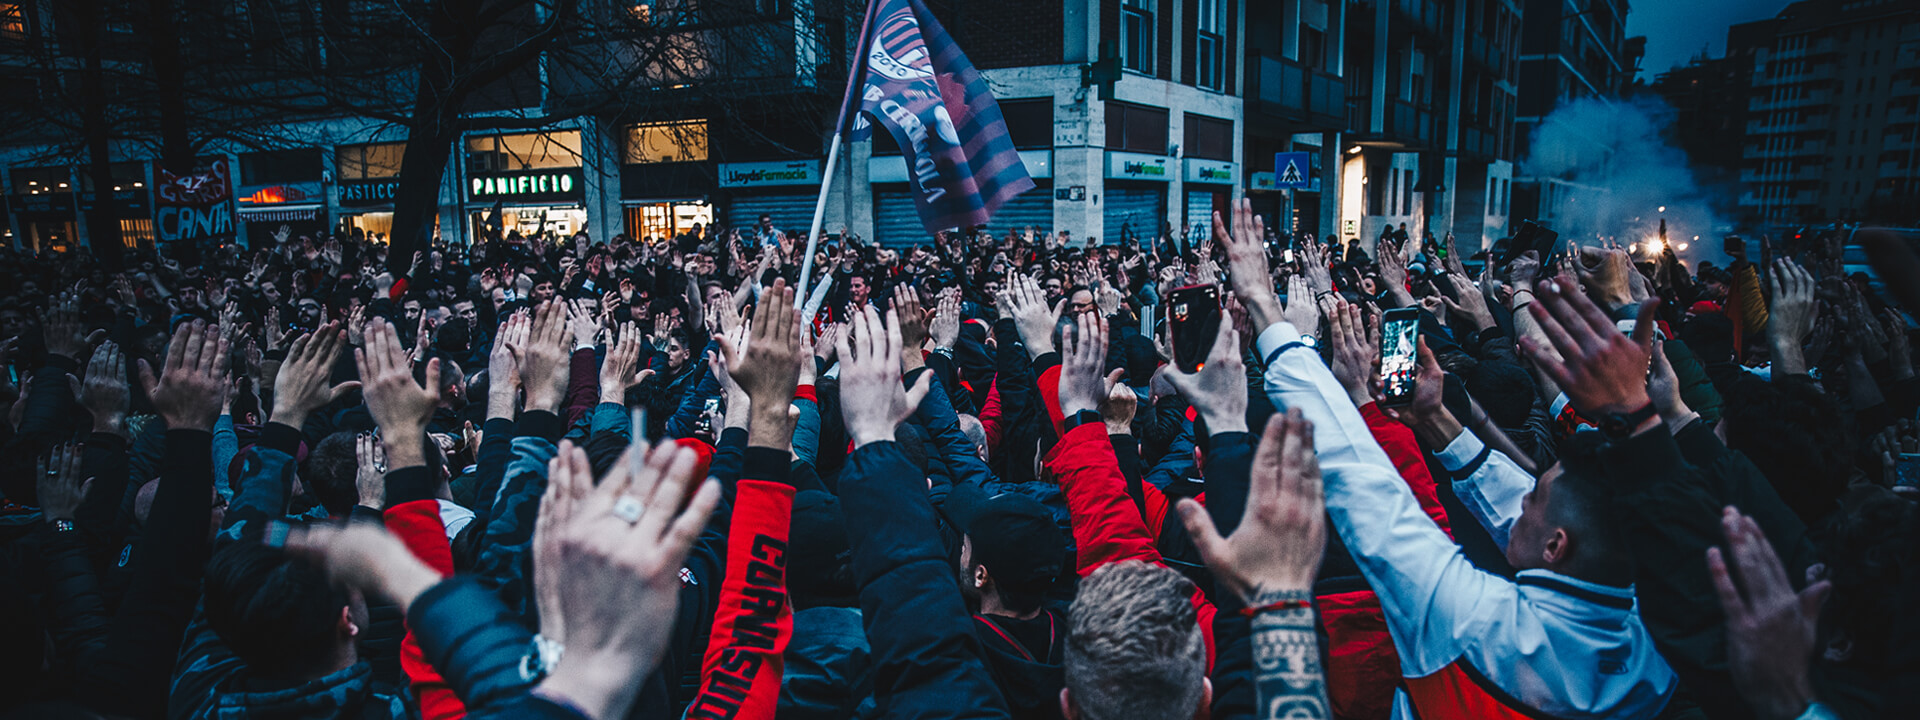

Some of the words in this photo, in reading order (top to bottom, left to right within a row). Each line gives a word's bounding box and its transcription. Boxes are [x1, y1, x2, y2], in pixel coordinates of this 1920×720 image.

[870, 51, 908, 77] 2010
[339, 182, 400, 201] PASTICC
[472, 174, 573, 196] PANIFICIO
[158, 199, 233, 241] CANTA
